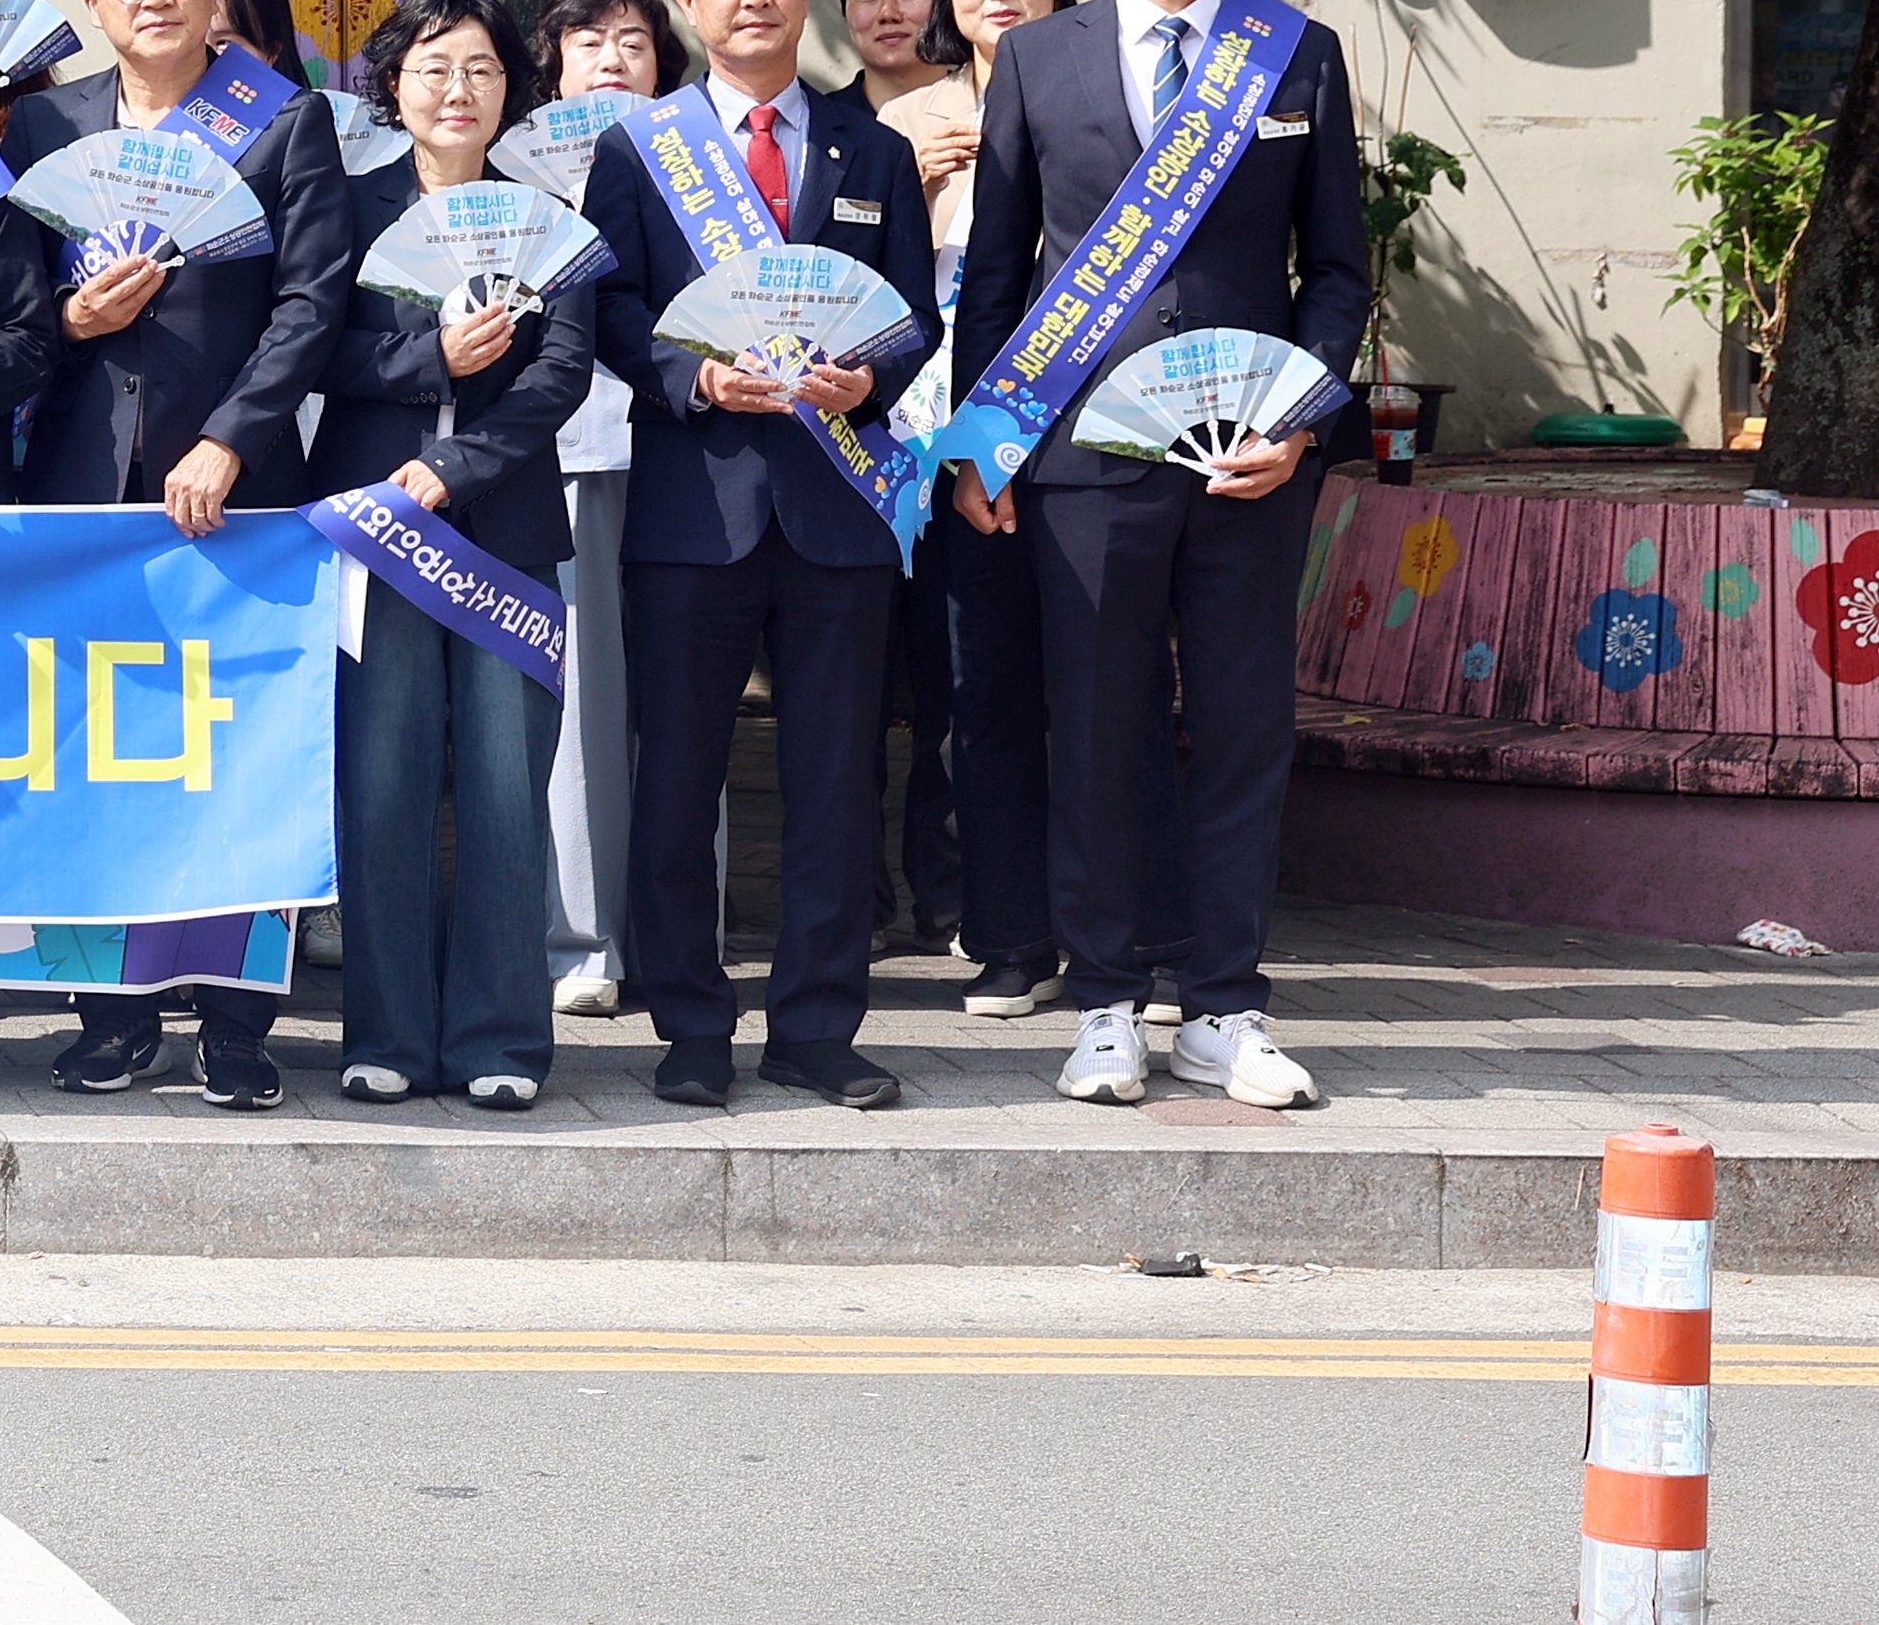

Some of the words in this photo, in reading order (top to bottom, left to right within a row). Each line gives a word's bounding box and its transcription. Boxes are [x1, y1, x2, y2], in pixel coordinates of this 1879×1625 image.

[1197, 30, 1253, 111] 성장하는
[184, 98, 249, 141] KFME
[121, 138, 193, 163] 함께합시다
[118, 154, 191, 180] 같이삽시다
[650, 126, 716, 216] 성장하는
[445, 192, 516, 211] 함께합시다
[448, 209, 517, 228] 같이삽시다
[1073, 204, 1154, 297] 함께하는
[758, 257, 832, 274] 함께합시다
[757, 274, 831, 289] 같이삽시다
[1012, 291, 1090, 381] 대한민국
[1160, 338, 1236, 364] 함께합시다
[1163, 355, 1239, 379] 같이삽시다
[897, 407, 936, 434] 화순군
